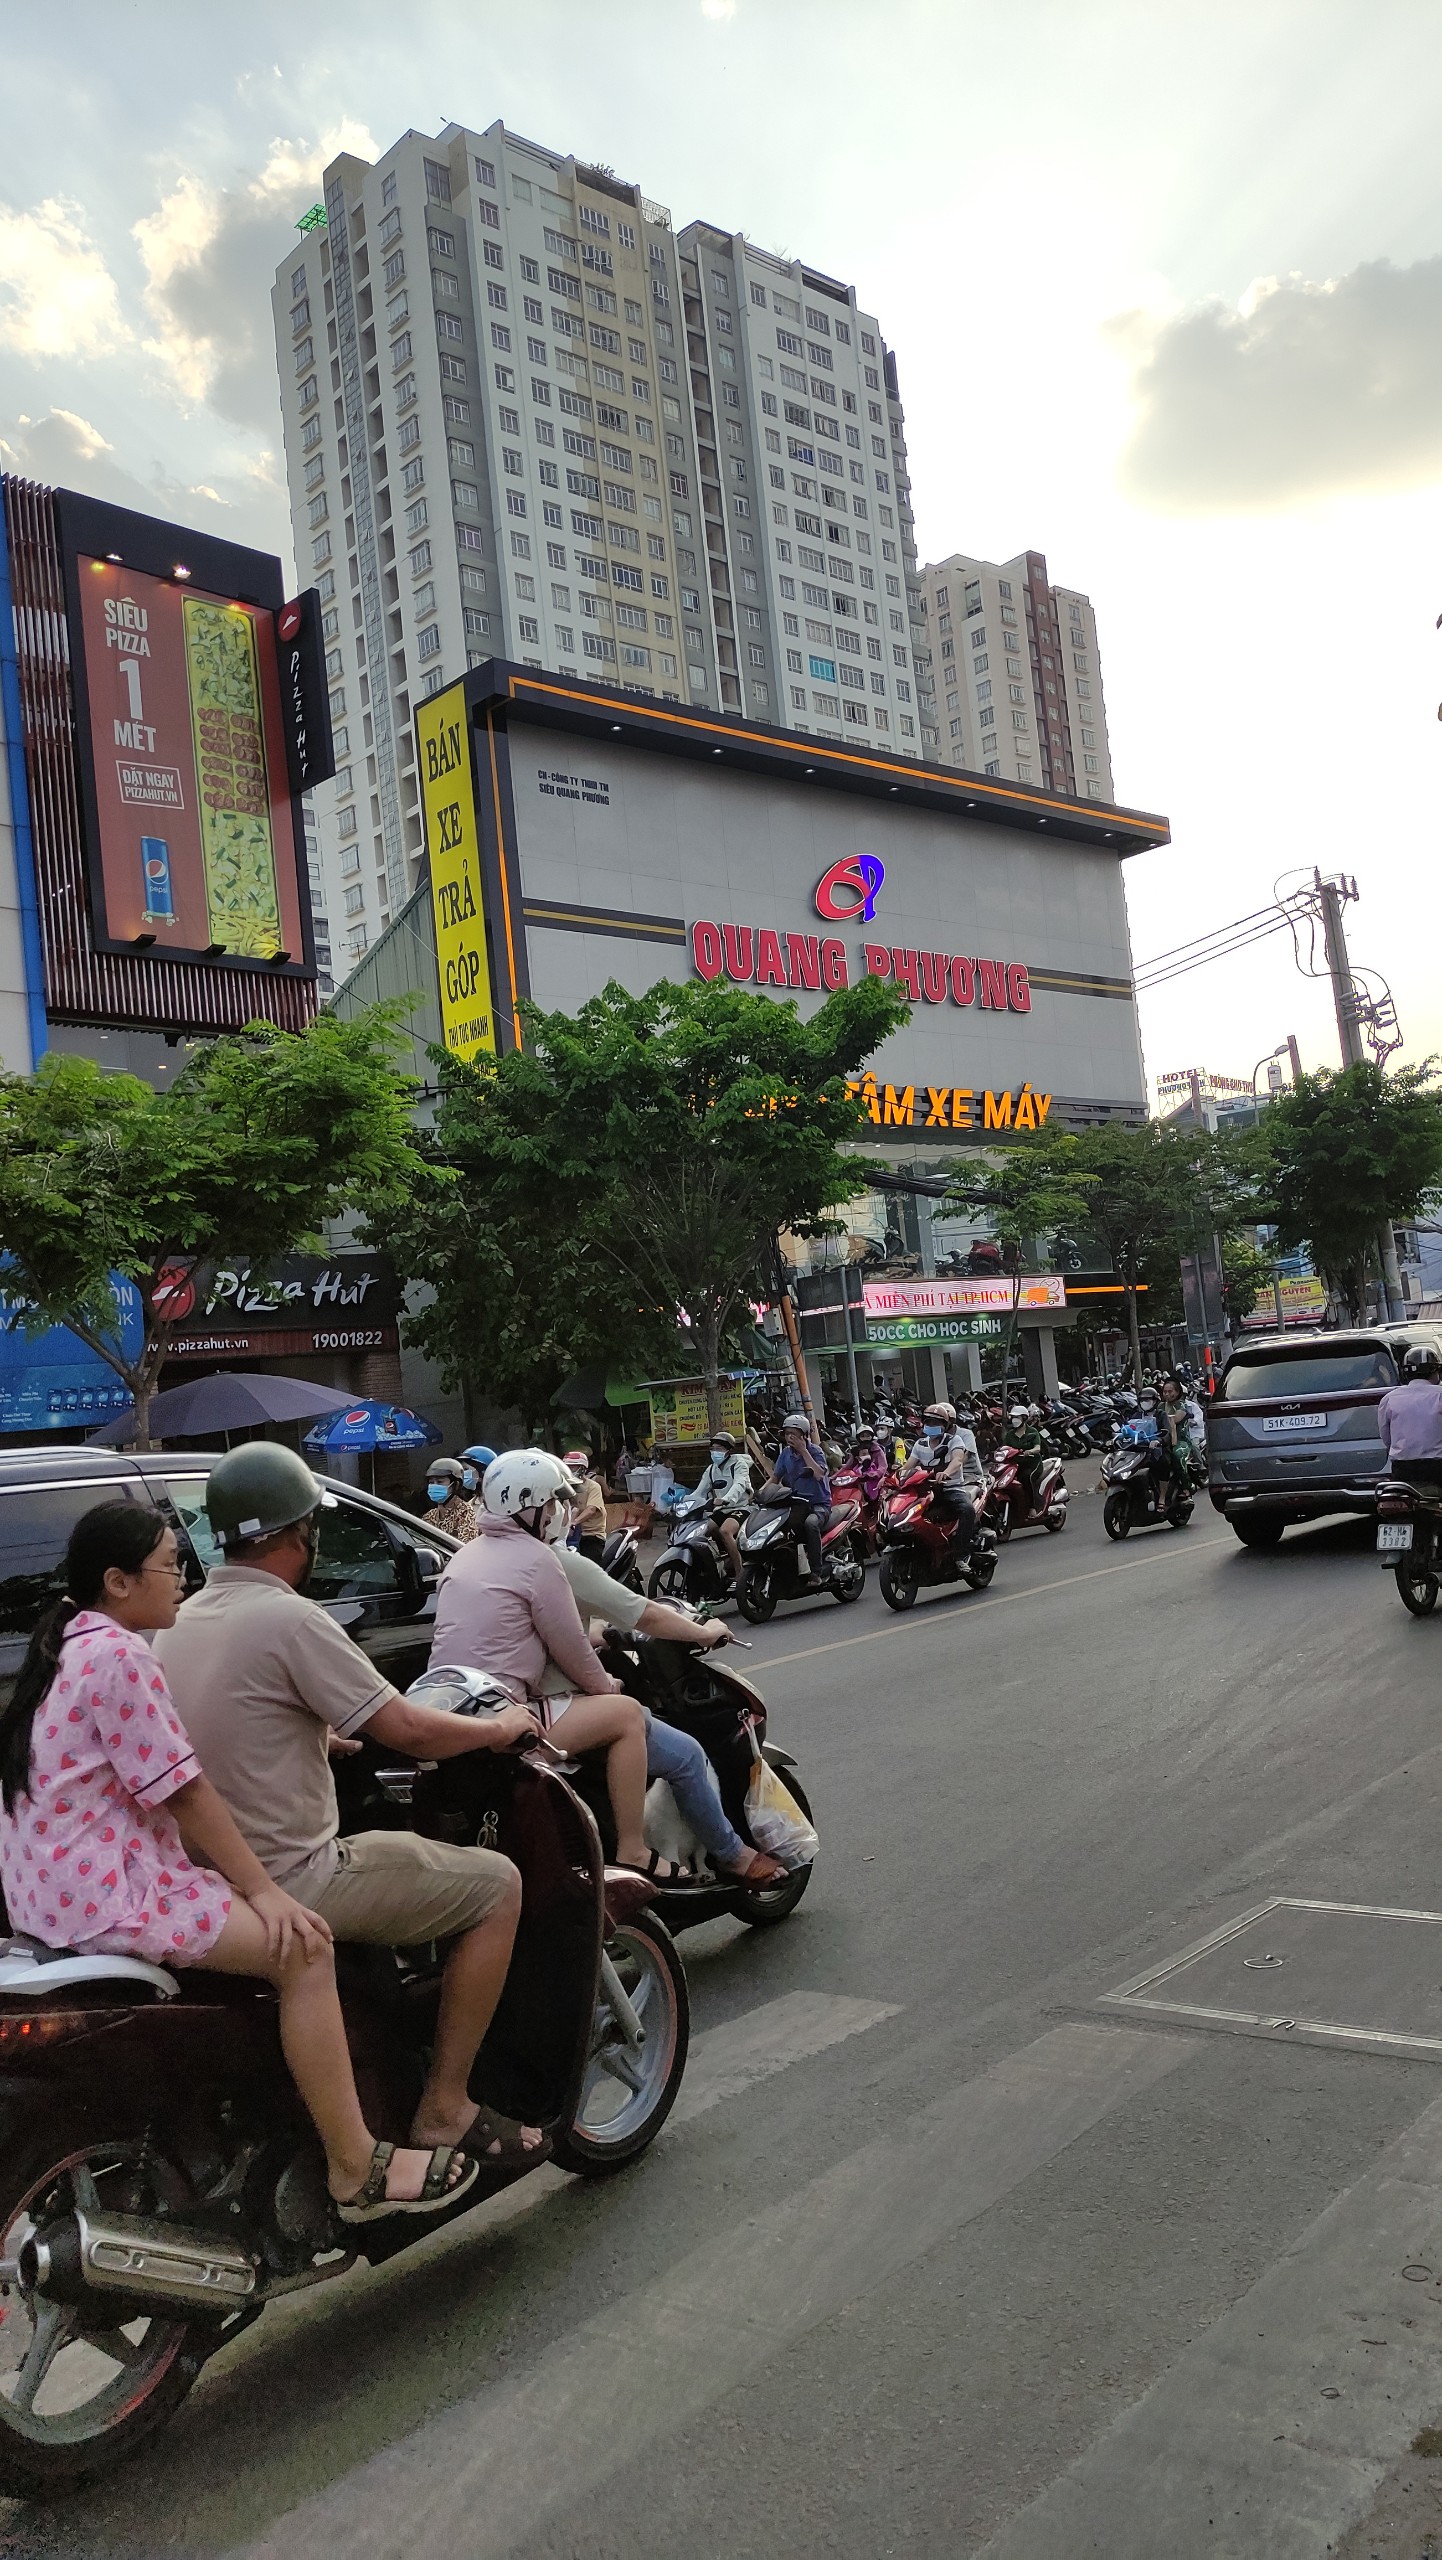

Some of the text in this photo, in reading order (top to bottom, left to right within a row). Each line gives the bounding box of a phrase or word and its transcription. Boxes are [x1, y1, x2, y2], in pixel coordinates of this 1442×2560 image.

[104, 597, 148, 631] SIÊU
[105, 627, 151, 657] PIZZA
[119, 658, 143, 720] 1
[290, 651, 309, 778] Pizza Hut
[113, 720, 156, 752] MÉT
[426, 717, 462, 783] BÁN
[122, 767, 174, 789] ĐẶT NGAY
[569, 776, 578, 786] TY
[125, 786, 178, 802] PIZZAHUT.VN
[556, 786, 580, 800] QUANG
[581, 791, 609, 805] PHƯƠNG
[437, 801, 463, 855] XE
[438, 858, 477, 930] TRẢ
[446, 941, 480, 1004] GÓP
[692, 919, 1033, 1013] QUANG PHƯƠNG
[469, 1014, 489, 1041] NHANH
[1162, 1069, 1200, 1083] HOTEL
[925, 1086, 973, 1128] XE
[984, 1083, 1053, 1130] MÁY
[205, 1269, 380, 1315] Pizza Hut
[913, 1289, 935, 1307] PHÍ
[938, 1292, 959, 1309] TẠI
[960, 1290, 1009, 1304] TP.HCM
[312, 1331, 383, 1349] 19001822
[868, 1319, 1001, 1341] 50CC CHO HỌC SINH
[343, 1427, 365, 1435] pepsi
[1268, 1415, 1320, 1428] 51K-409.72
